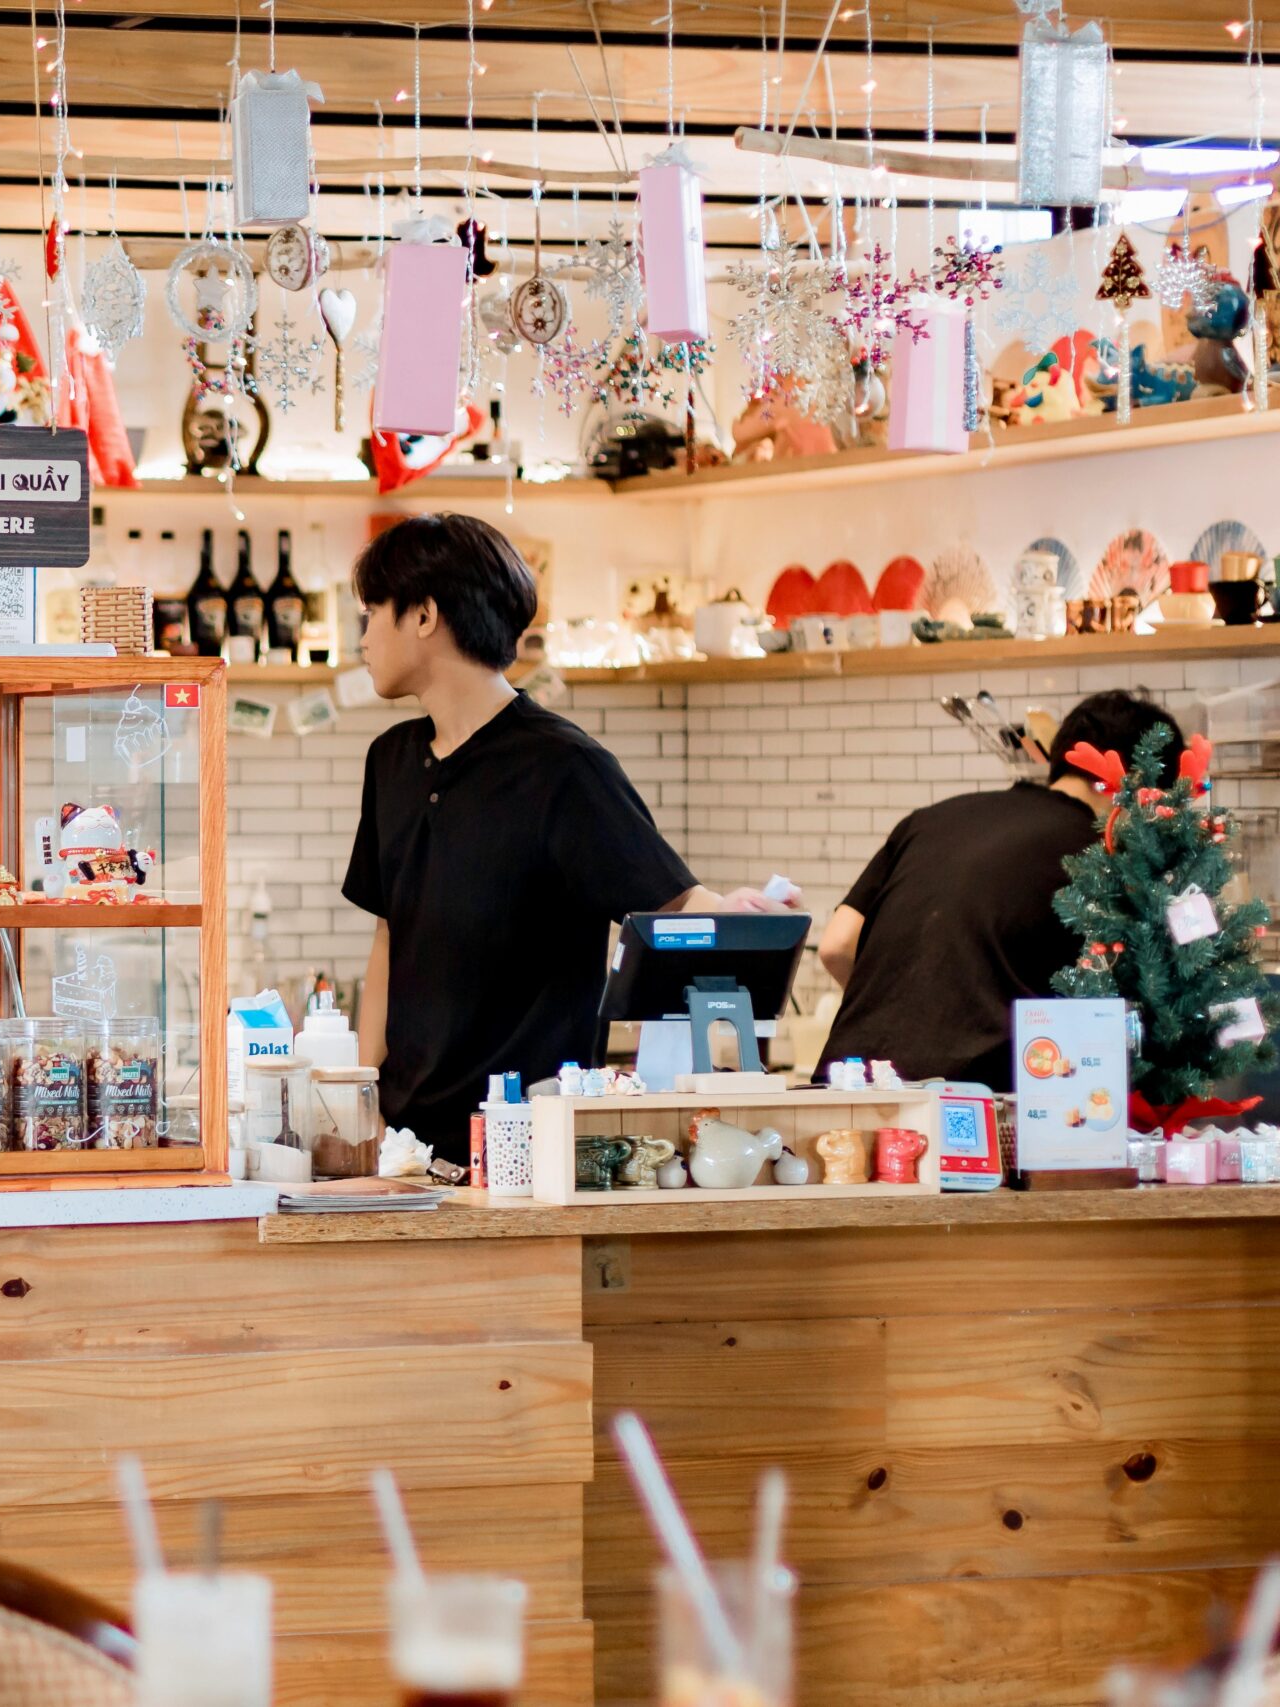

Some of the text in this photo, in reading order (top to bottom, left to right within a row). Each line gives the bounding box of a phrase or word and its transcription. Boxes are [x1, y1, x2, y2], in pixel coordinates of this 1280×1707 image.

[12, 465, 70, 492] QUẦY
[248, 1042, 289, 1056] Dalat
[34, 1085, 80, 1099] Mixed Nuts
[105, 1083, 153, 1098] Mixed Nuts
